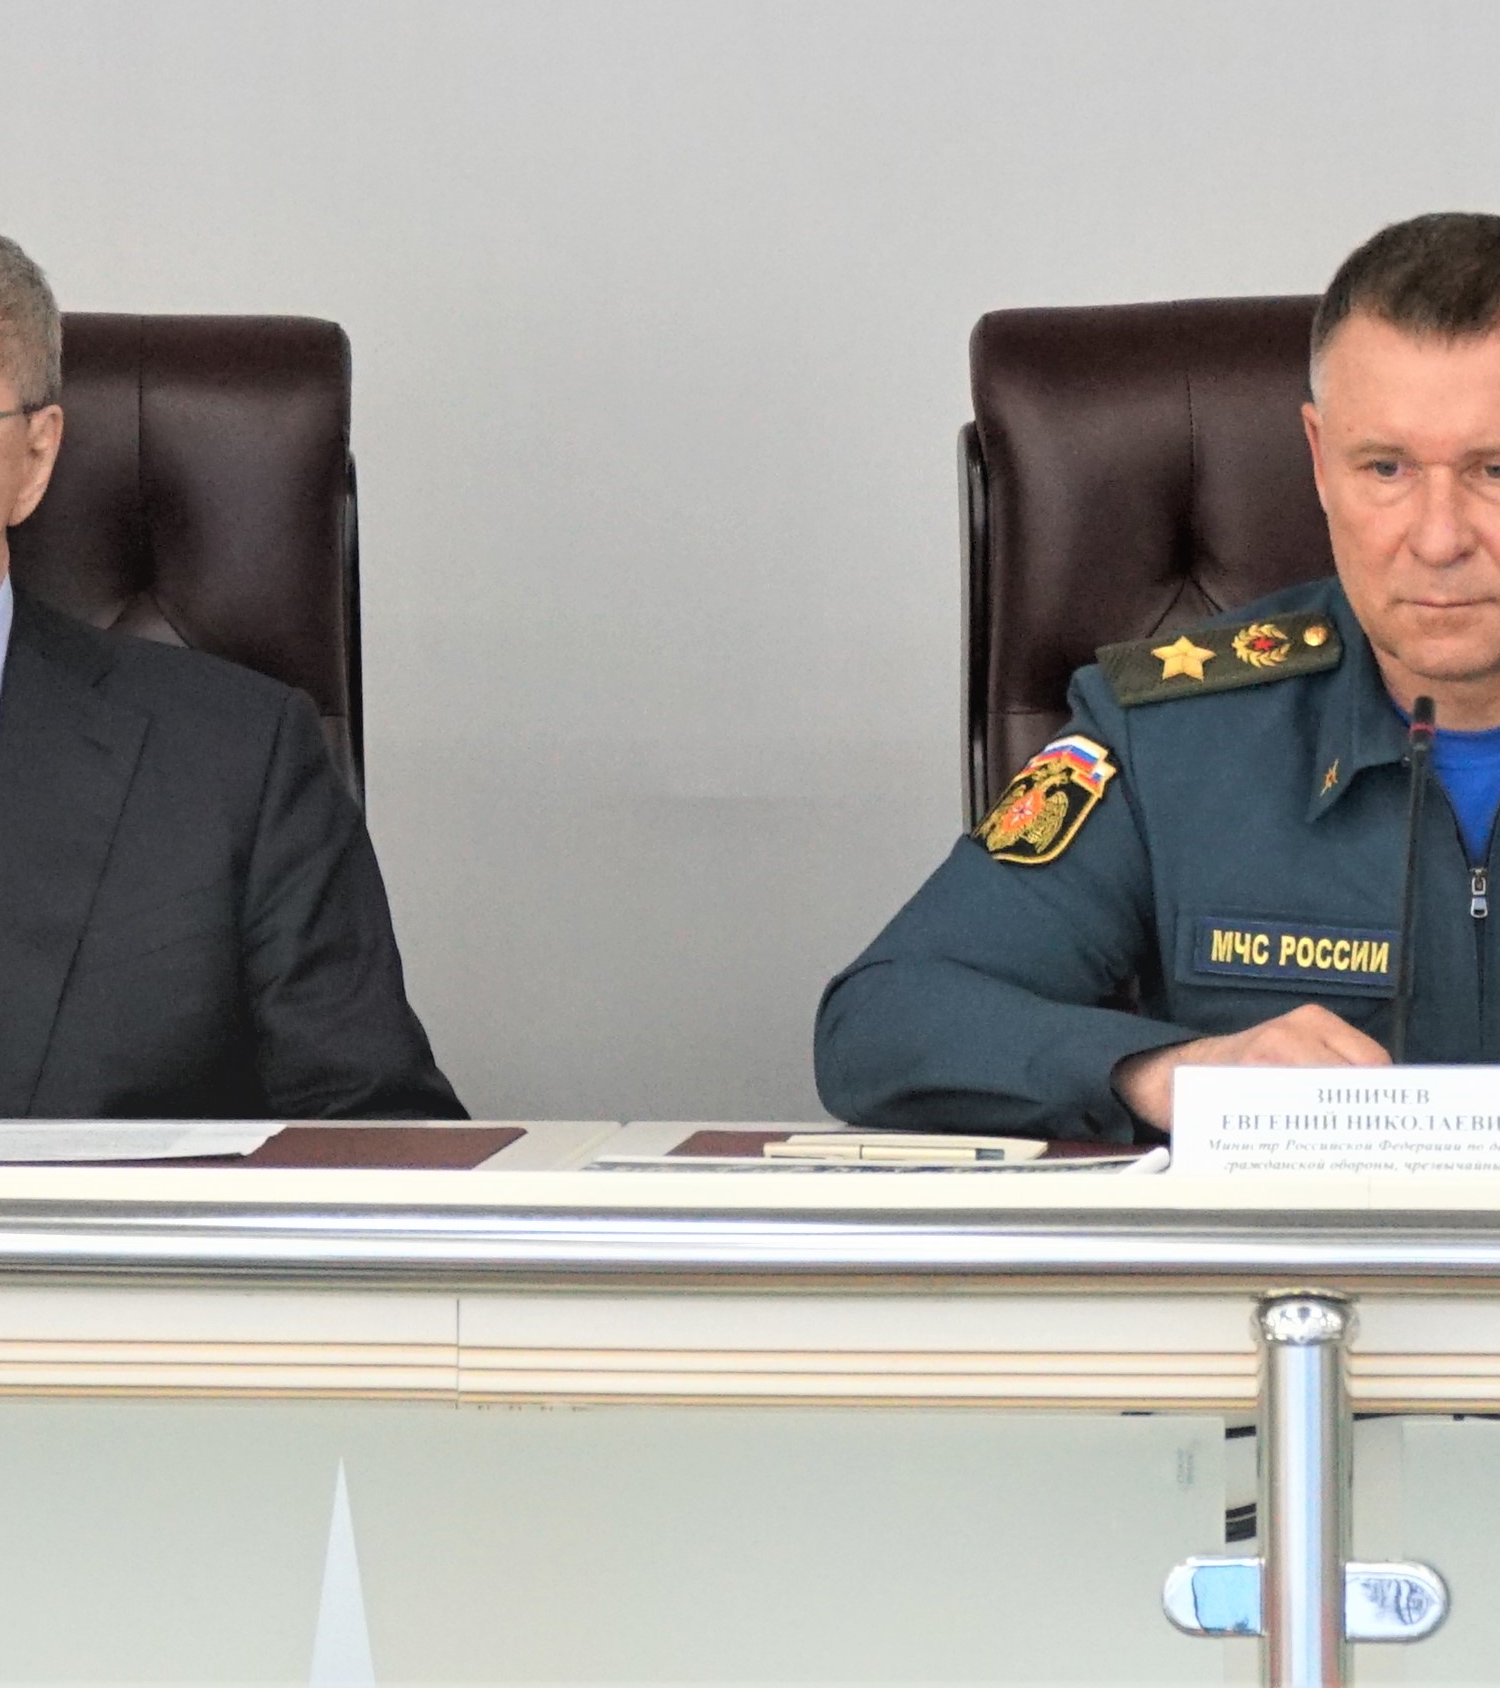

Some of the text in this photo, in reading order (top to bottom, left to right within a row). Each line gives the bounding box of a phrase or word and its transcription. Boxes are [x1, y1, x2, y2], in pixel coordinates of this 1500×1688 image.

[1210, 928, 1390, 974] МЧС РОССИИ
[1316, 1088, 1431, 1105] ЗИНИЧЕВ
[1221, 1111, 1338, 1131] ЕВГЕНИЙ
